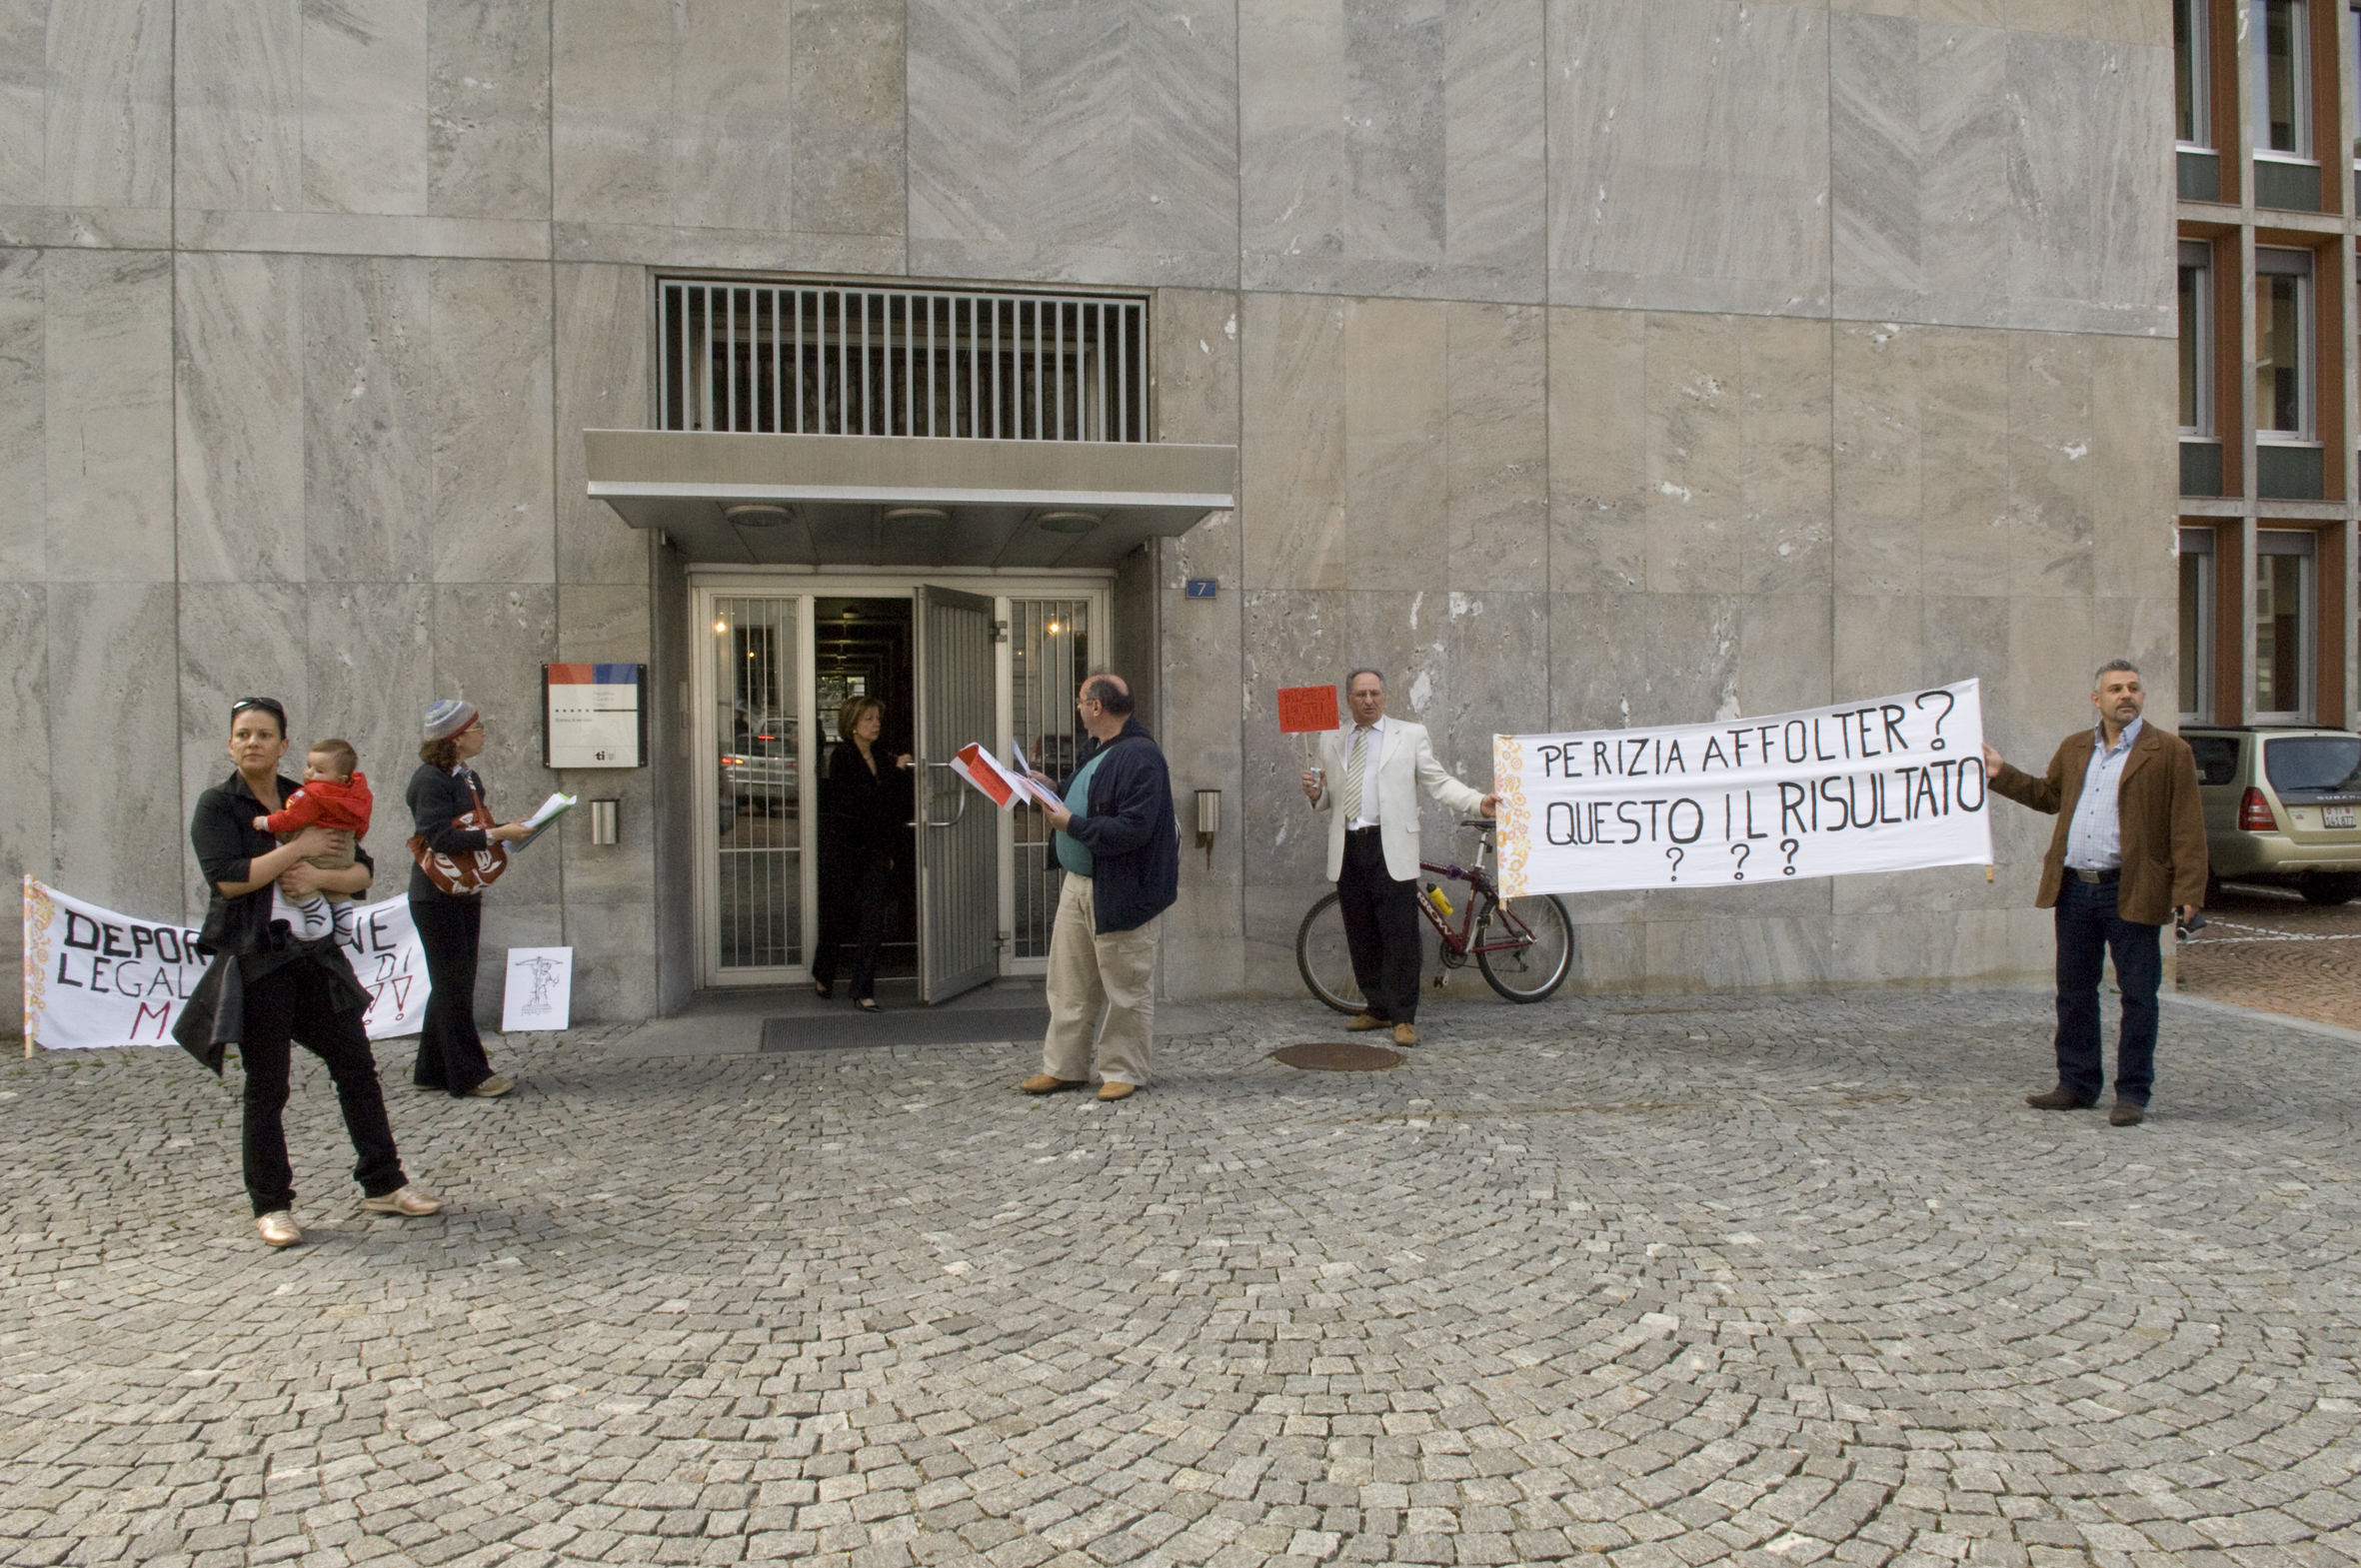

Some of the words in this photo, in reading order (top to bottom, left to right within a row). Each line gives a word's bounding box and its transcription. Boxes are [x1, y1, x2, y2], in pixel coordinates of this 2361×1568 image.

[1196, 583, 1206, 597] 7
[595, 751, 606, 761] ti
[1537, 738, 1685, 778] PERIZIA
[1546, 797, 1703, 845] QUESTO
[1725, 789, 1768, 841] IL
[1777, 757, 1984, 835] RISULTATO
[1417, 890, 1452, 935] RROW
[57, 948, 192, 999] LEGAL
